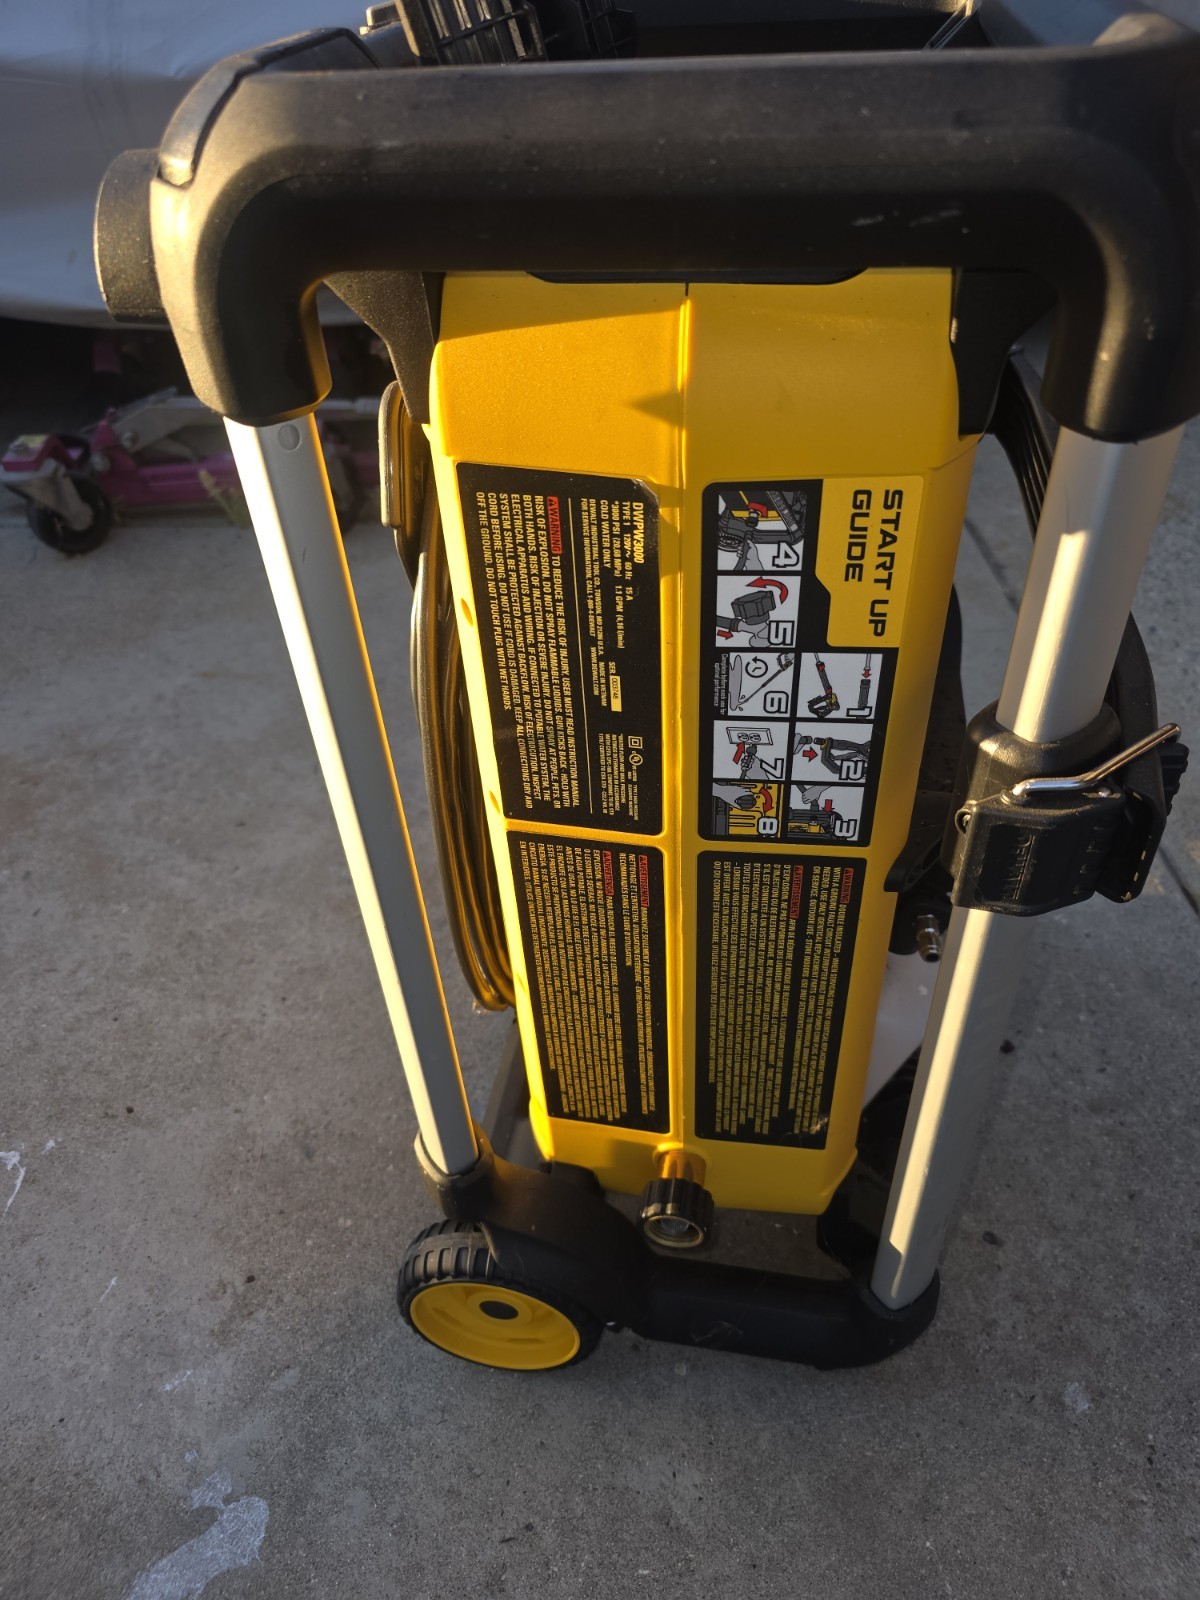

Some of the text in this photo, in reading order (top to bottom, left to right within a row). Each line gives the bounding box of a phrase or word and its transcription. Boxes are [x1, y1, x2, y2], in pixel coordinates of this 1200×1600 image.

[476, 492, 486, 507] OFF
[488, 493, 499, 516] CORD
[523, 495, 533, 519] BOTH
[534, 496, 544, 515] RISK
[580, 499, 588, 510] FOR
[479, 510, 489, 525] THE
[499, 493, 511, 529] SYSTEM
[511, 494, 524, 544] ELECTRICAL
[589, 499, 597, 524] DEWALT
[622, 502, 630, 520] TYPE
[536, 518, 545, 529] OF
[548, 507, 561, 553] WARNING
[581, 512, 589, 536] SERVICE
[611, 522, 620, 534] PSI
[632, 502, 645, 563] DWPW3000
[491, 519, 503, 550] BEFORE
[590, 526, 599, 560] INDUSTRIAL
[600, 500, 611, 568] COLD WATER ONLY
[844, 489, 872, 582] GUIDE
[504, 531, 514, 557] SHALL
[507, 559, 516, 570] BE
[552, 556, 560, 566] TO
[772, 542, 800, 568] 4
[868, 490, 904, 637] START UP
[486, 568, 495, 579] DO
[516, 546, 529, 594] APPARATUS
[529, 556, 538, 574] RISK
[592, 562, 600, 576] TOOL
[624, 562, 632, 570] 60
[531, 576, 539, 586] OF
[553, 569, 563, 599] REDUCE
[625, 571, 632, 580] Hz
[488, 581, 497, 597] NOT
[499, 583, 508, 594] DO
[508, 572, 521, 616] PROTECTED
[542, 582, 551, 593] DO
[625, 586, 633, 594] 15
[490, 600, 501, 625] TOUCH
[500, 596, 510, 612] NOT
[522, 596, 531, 613] AND
[532, 588, 543, 629] INJECTION
[543, 595, 553, 611] NOT
[556, 602, 564, 616] THE
[615, 596, 623, 612] GPM
[502, 613, 512, 628] USE
[545, 613, 555, 637] SPRAY
[557, 618, 566, 635] RISK
[494, 627, 503, 646] PLUG
[514, 618, 525, 652] AGAINST
[536, 631, 545, 641] OR
[559, 637, 567, 647] OF
[768, 621, 795, 646] 5
[496, 648, 506, 667] WITH
[505, 638, 515, 658] CORD
[537, 643, 547, 670] SEVERE
[548, 639, 559, 683] FLAMMABLE
[499, 669, 508, 684] WET
[528, 655, 540, 697] CONNECTED
[562, 678, 571, 696] USER
[522, 695, 531, 710] RISK
[533, 699, 541, 707] TO
[543, 699, 551, 709] DO
[564, 697, 573, 717] MUST
[764, 691, 789, 714] 6
[846, 706, 872, 718] 1
[513, 707, 523, 723] KEEP
[524, 712, 532, 720] OF
[534, 709, 544, 737] POTABLE
[544, 710, 552, 724] NOT
[555, 715, 563, 730] GUN
[516, 725, 524, 737] ALL
[546, 726, 555, 746] SPRAY
[566, 718, 574, 735] READ
[537, 739, 546, 761] WATER
[556, 731, 565, 750] KICKS
[517, 739, 529, 781] CONNECTIONS
[558, 751, 567, 768] BACK
[567, 737, 577, 779] INSTRUCTION
[761, 758, 784, 779] 7
[839, 760, 865, 780] 2
[522, 782, 531, 794] DRY
[531, 774, 541, 799] INSPECT
[560, 774, 569, 790] HOLD
[524, 796, 532, 809] AND
[542, 790, 550, 801] THE
[553, 800, 560, 808] OR
[562, 791, 570, 807] WITH
[757, 817, 779, 836] 8
[834, 819, 857, 838] 3
[603, 858, 613, 895] ADVERTENCIA
[640, 862, 648, 906] AVERTISSEMENT
[790, 872, 802, 917] AVERTISSEMENT
[827, 867, 841, 927] WITH GROUND FAULT
[841, 875, 851, 903] WARNING
[837, 904, 846, 924] DOUBLE
